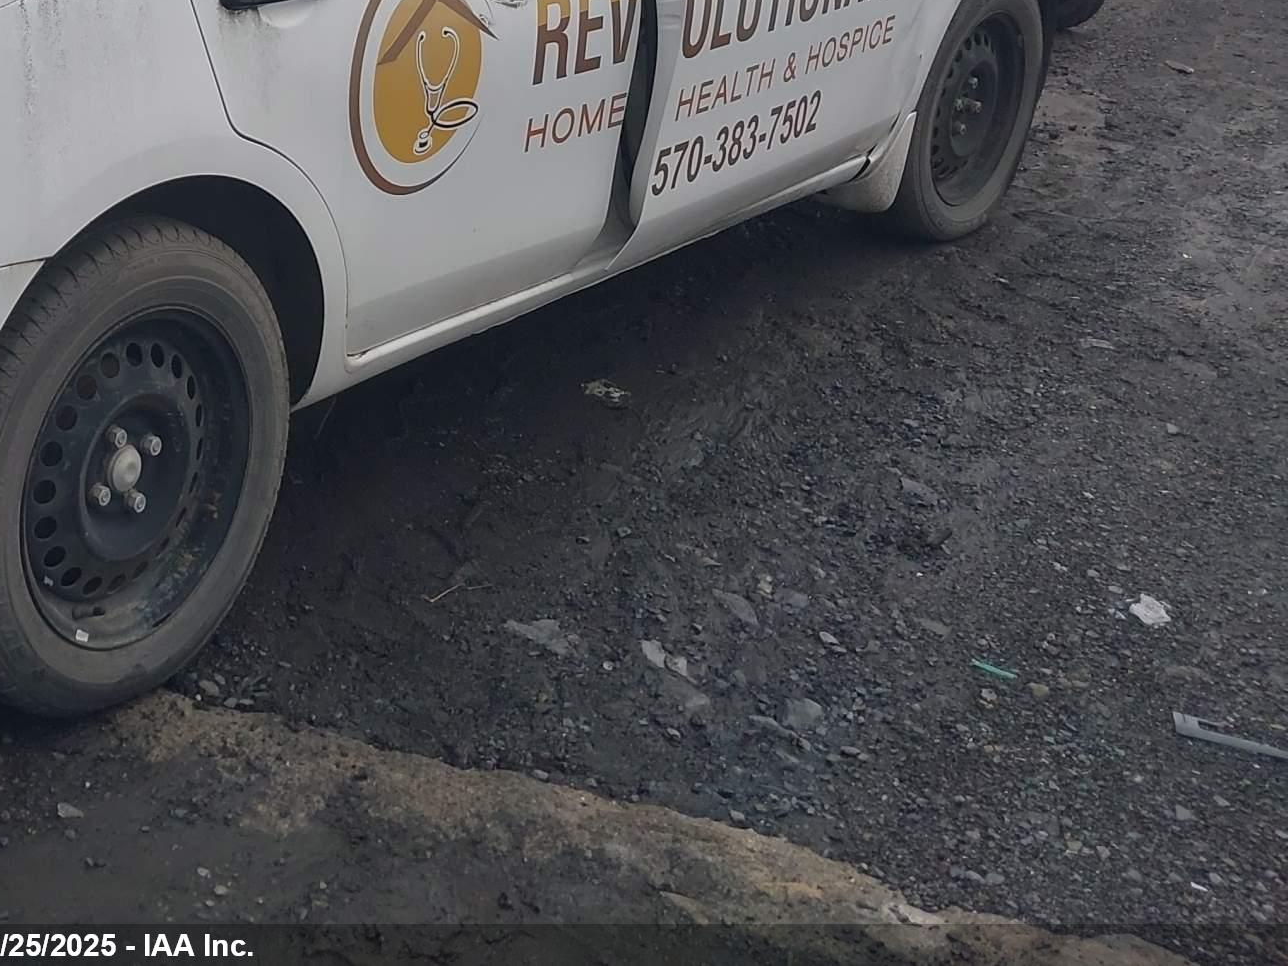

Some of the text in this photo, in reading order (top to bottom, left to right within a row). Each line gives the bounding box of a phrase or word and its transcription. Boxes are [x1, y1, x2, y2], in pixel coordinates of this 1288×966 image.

[524, 15, 896, 153] HOME HEALTH & HOSPICE
[651, 90, 821, 196] 570-383-7502
